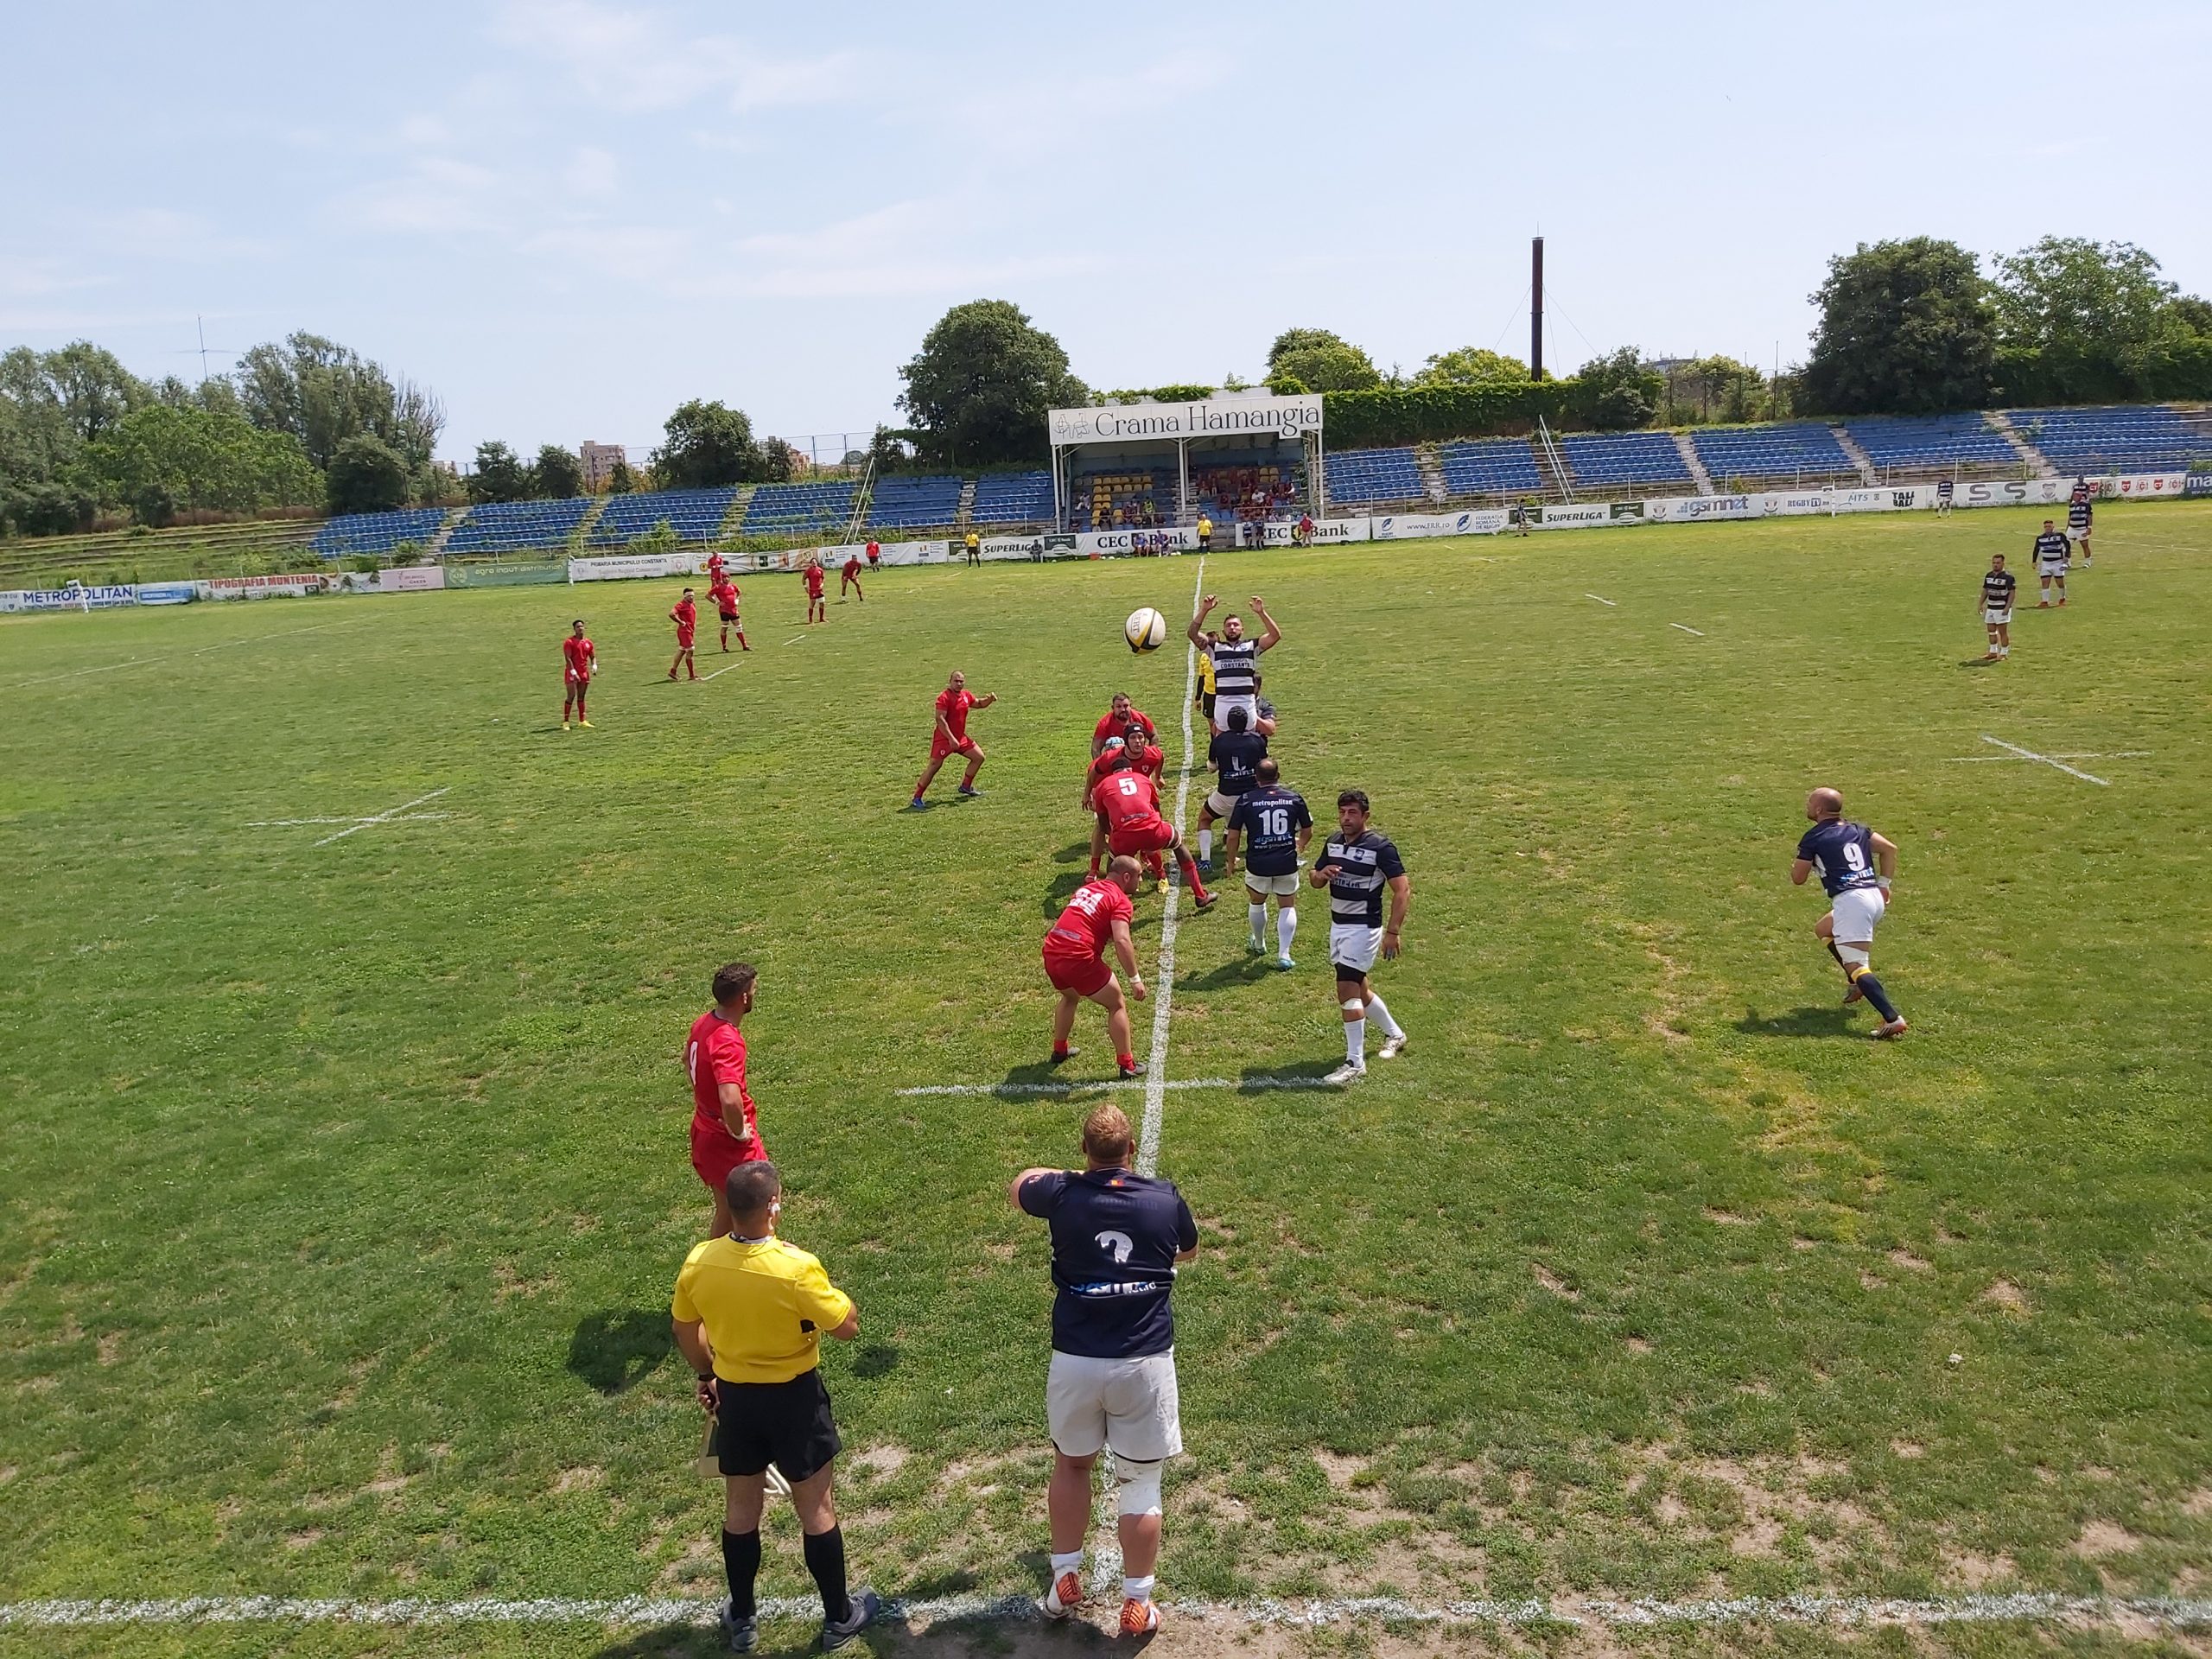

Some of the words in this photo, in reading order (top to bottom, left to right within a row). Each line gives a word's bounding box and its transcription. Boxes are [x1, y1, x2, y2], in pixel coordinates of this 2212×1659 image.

[1095, 412, 1180, 436] Crama
[1188, 400, 1319, 437] Hamangia
[1097, 536, 1128, 549] CEC
[1148, 531, 1188, 546] Bnk
[1263, 527, 1287, 540] EC
[1310, 523, 1350, 537] Bank
[22, 586, 132, 604] METROPOLITAN
[1118, 777, 1138, 796] 5
[1252, 798, 1294, 808] metropolitan
[1258, 808, 1289, 836] 16
[1842, 842, 1866, 872] 9
